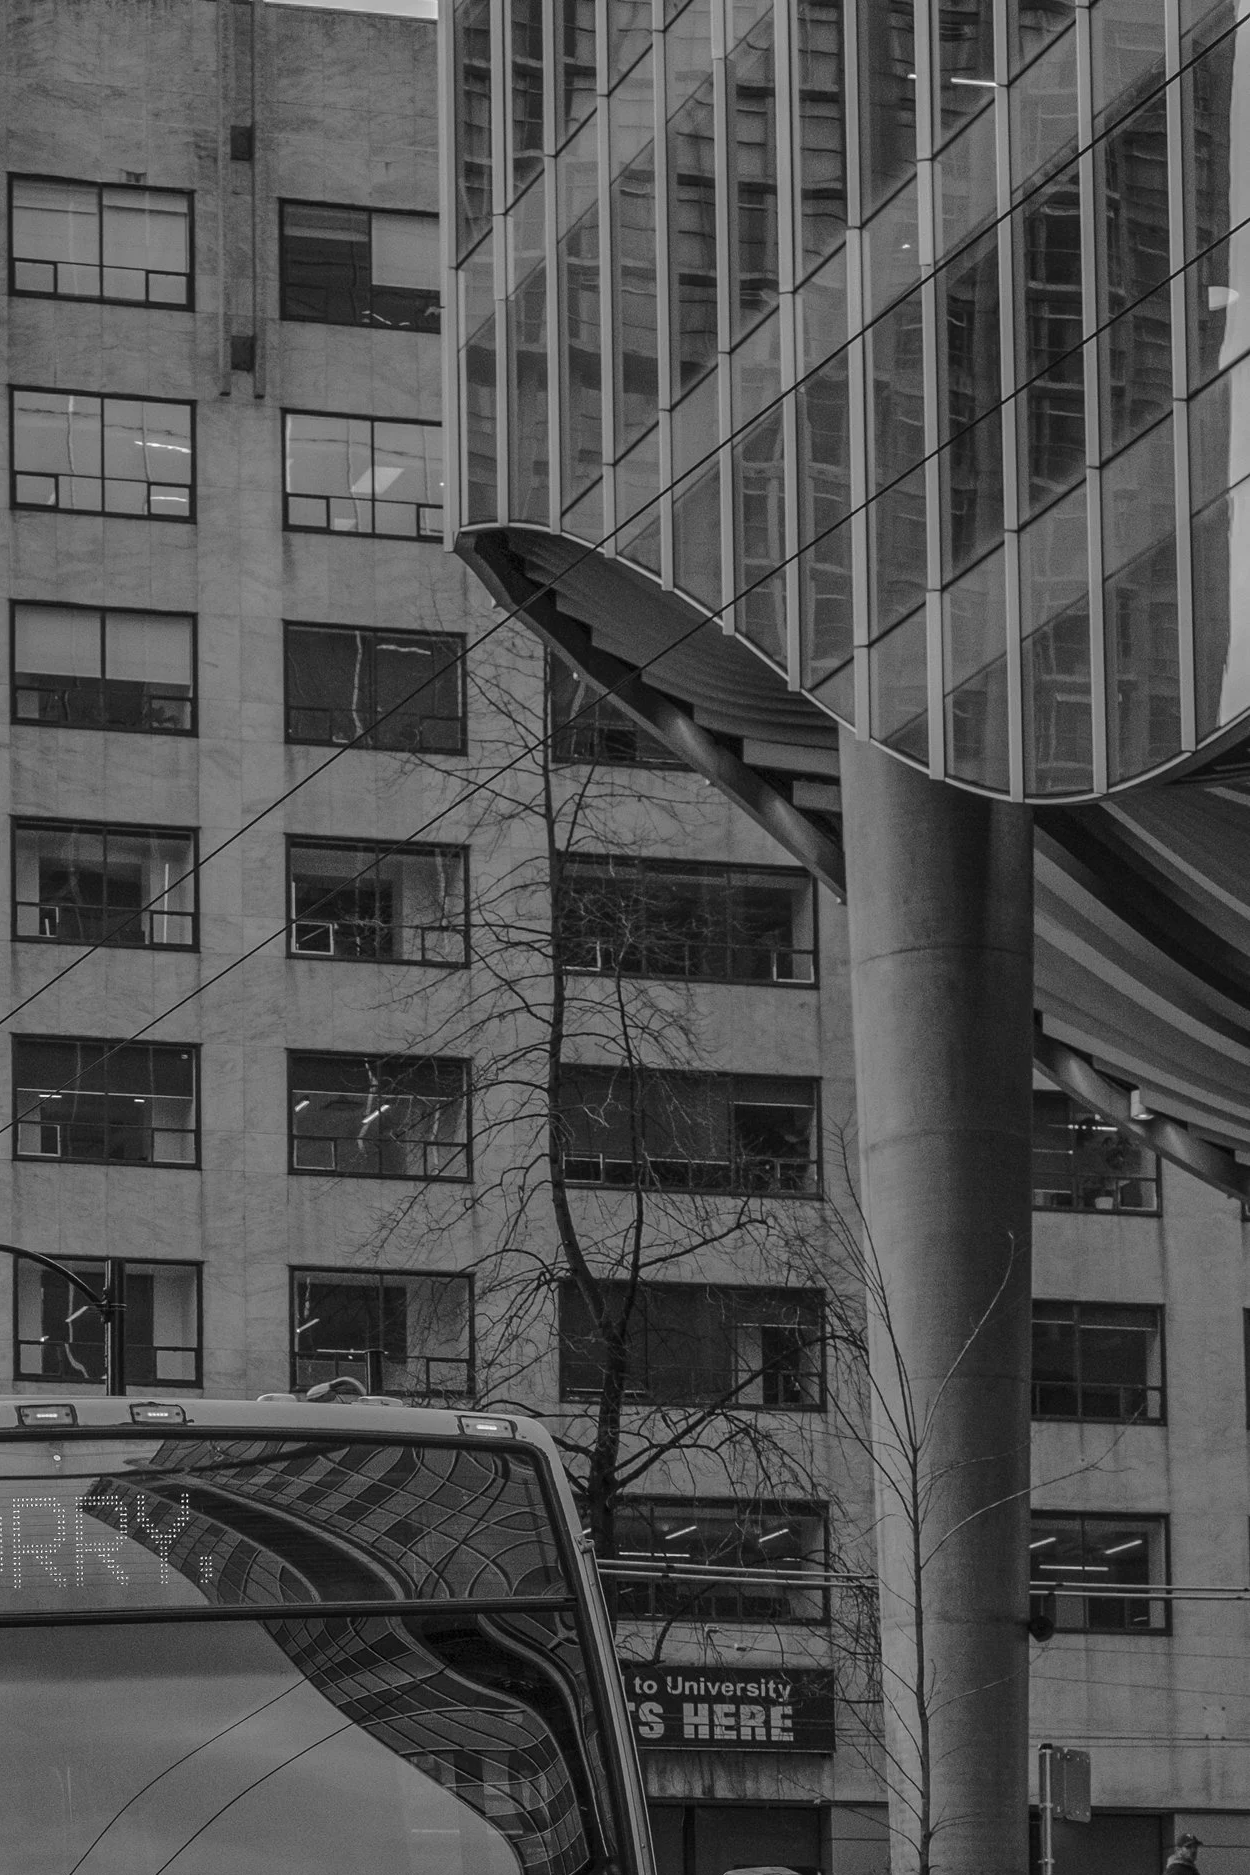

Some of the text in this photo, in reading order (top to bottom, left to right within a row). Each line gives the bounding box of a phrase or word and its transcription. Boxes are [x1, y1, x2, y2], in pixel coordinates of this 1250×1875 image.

[633, 1676, 658, 1695] to
[666, 1675, 792, 1703] University
[682, 1703, 795, 1742] HERE
